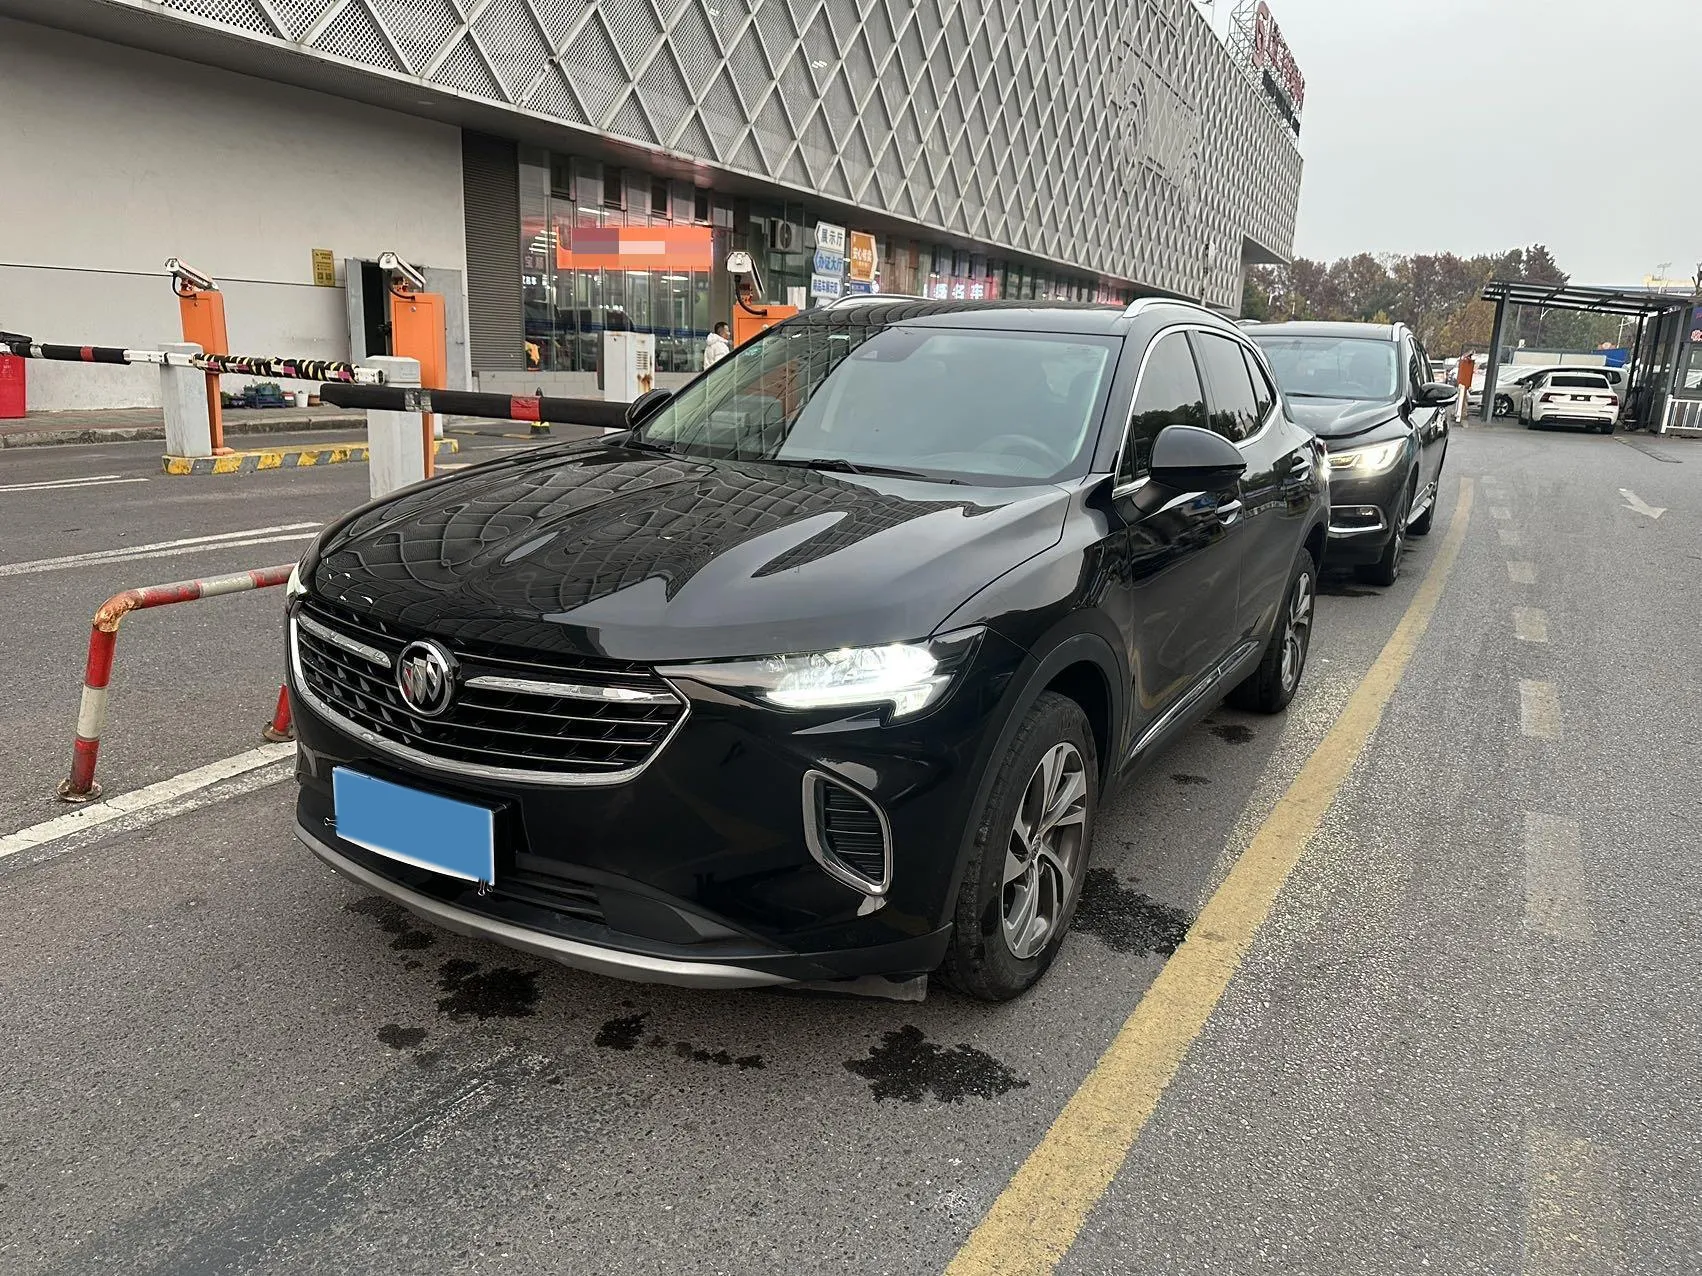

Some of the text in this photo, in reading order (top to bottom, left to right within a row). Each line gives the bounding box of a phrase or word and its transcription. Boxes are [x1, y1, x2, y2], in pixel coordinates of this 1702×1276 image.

[821, 228, 843, 247] 展示厅
[816, 253, 843, 271] 办证大厅
